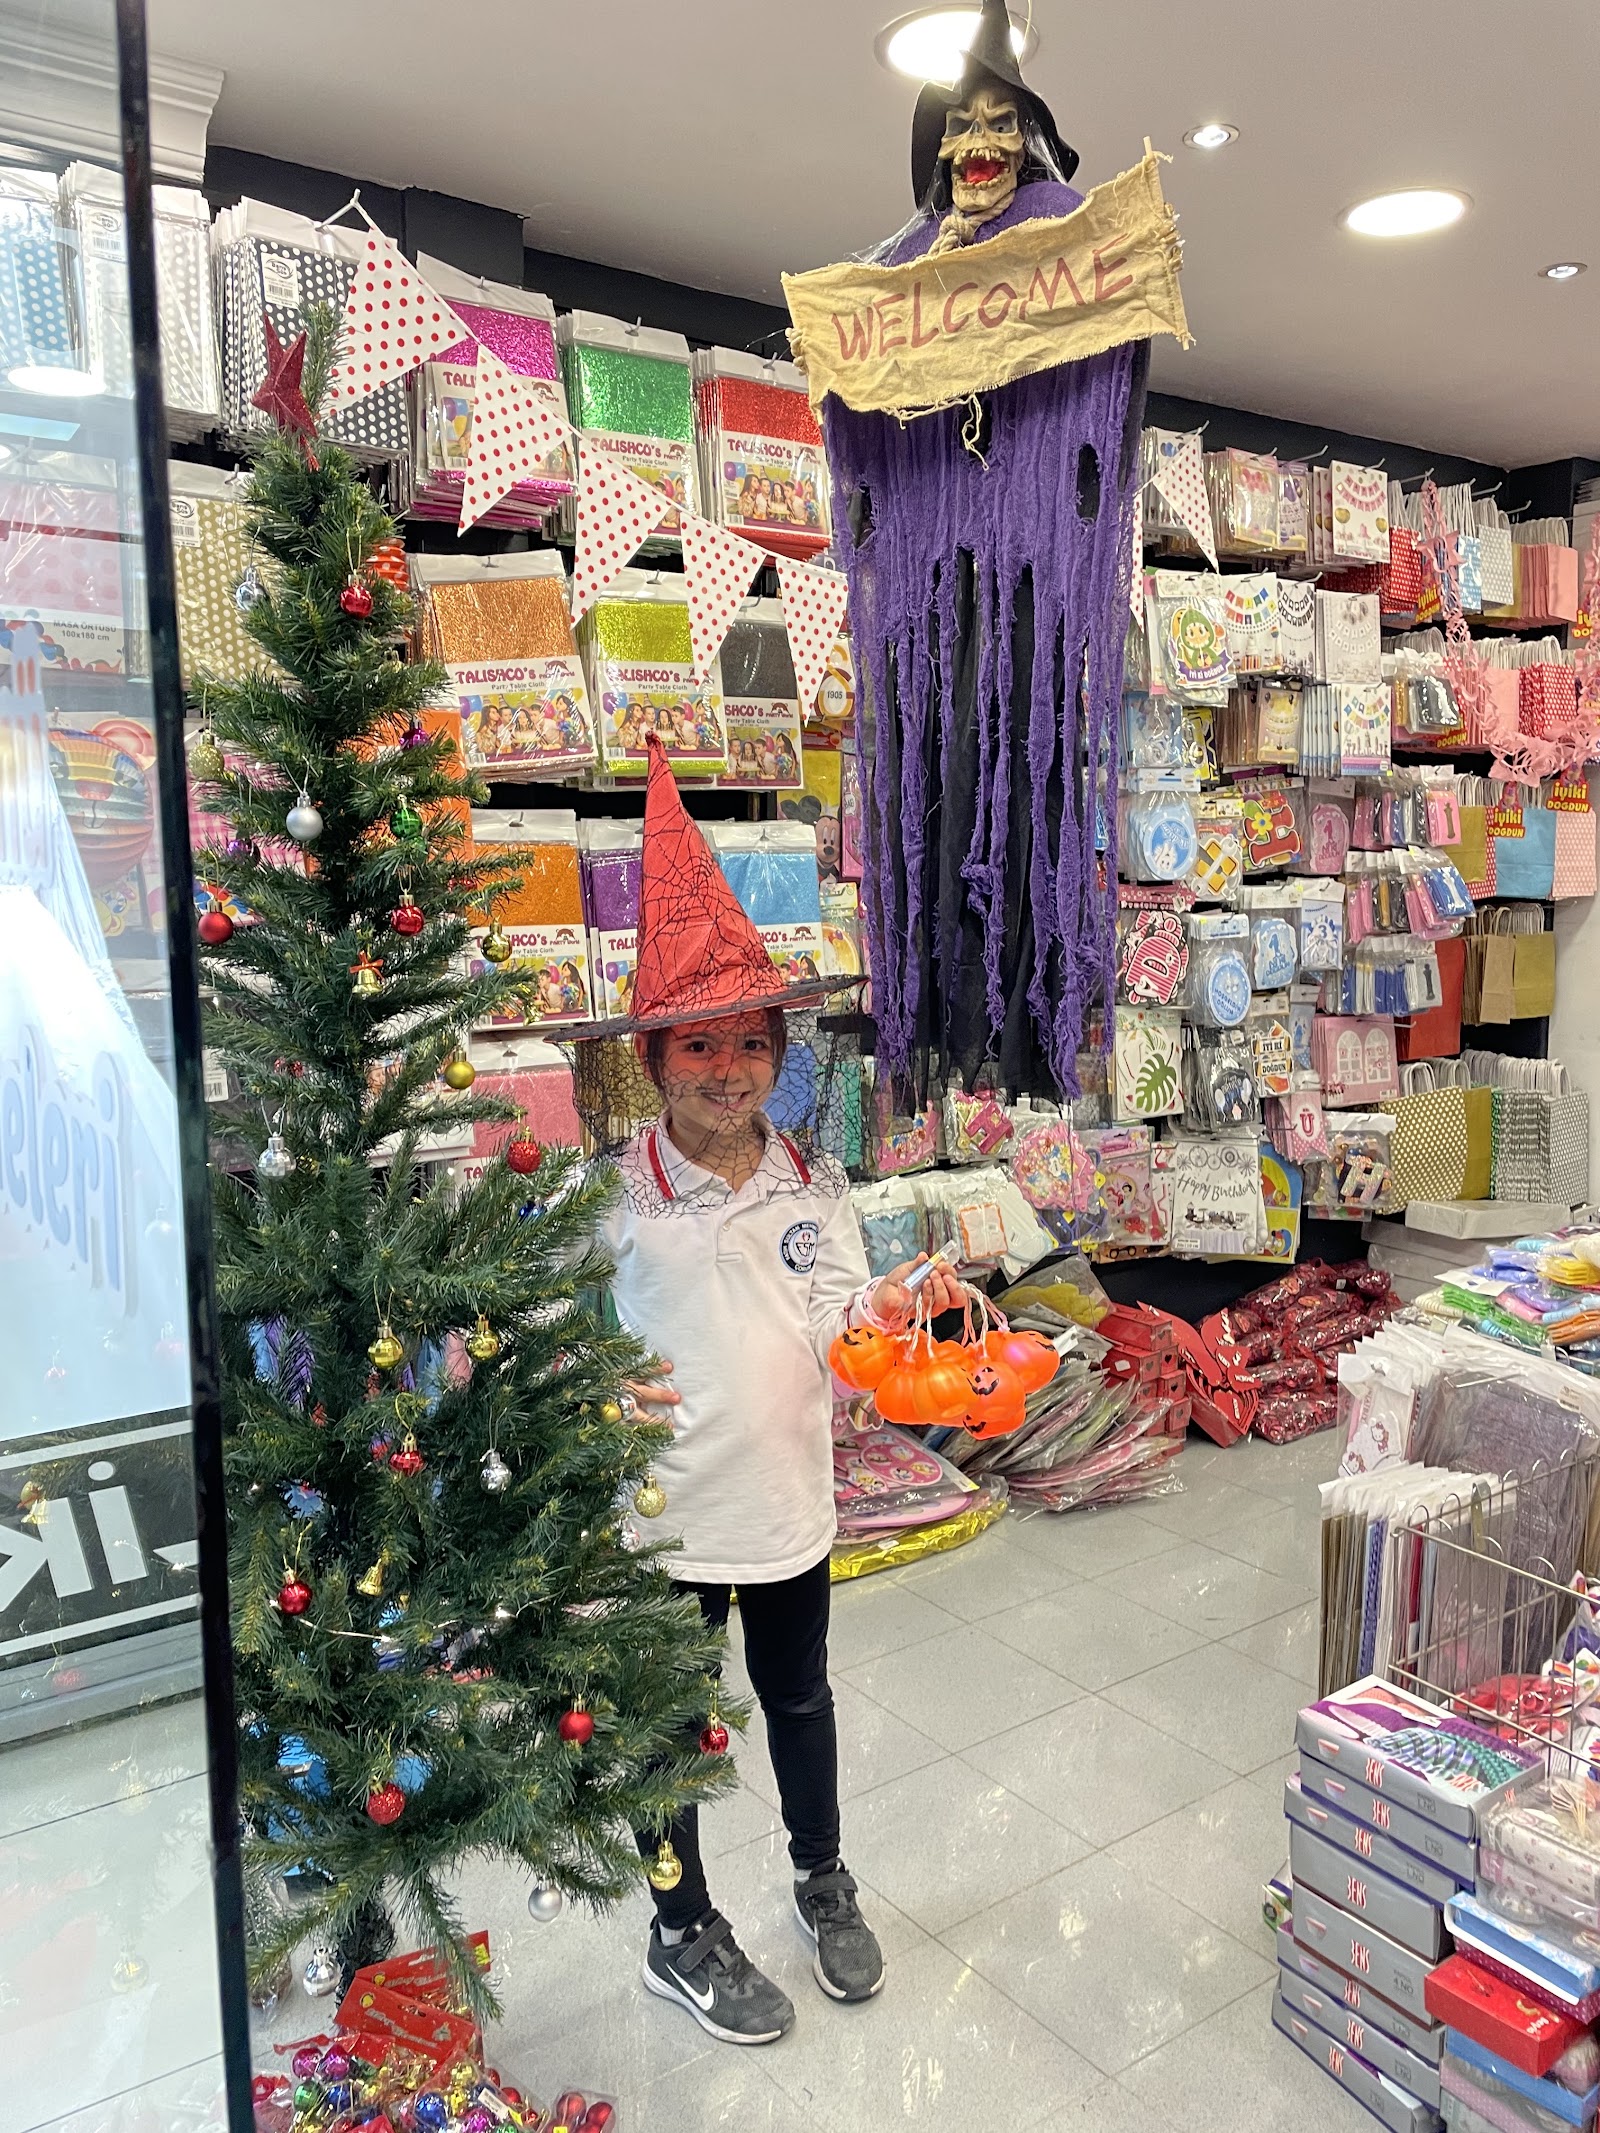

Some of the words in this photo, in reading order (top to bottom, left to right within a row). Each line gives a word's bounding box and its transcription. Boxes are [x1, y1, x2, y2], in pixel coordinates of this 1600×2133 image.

[831, 233, 1134, 362] WELCOME
[62, 630, 95, 640] 100x180
[455, 667, 536, 684] TALISHCO's
[827, 691, 843, 699] 1905
[724, 705, 764, 717] SHCO's
[1177, 1173, 1211, 1201] Happy
[1212, 1179, 1257, 1202] Birthday
